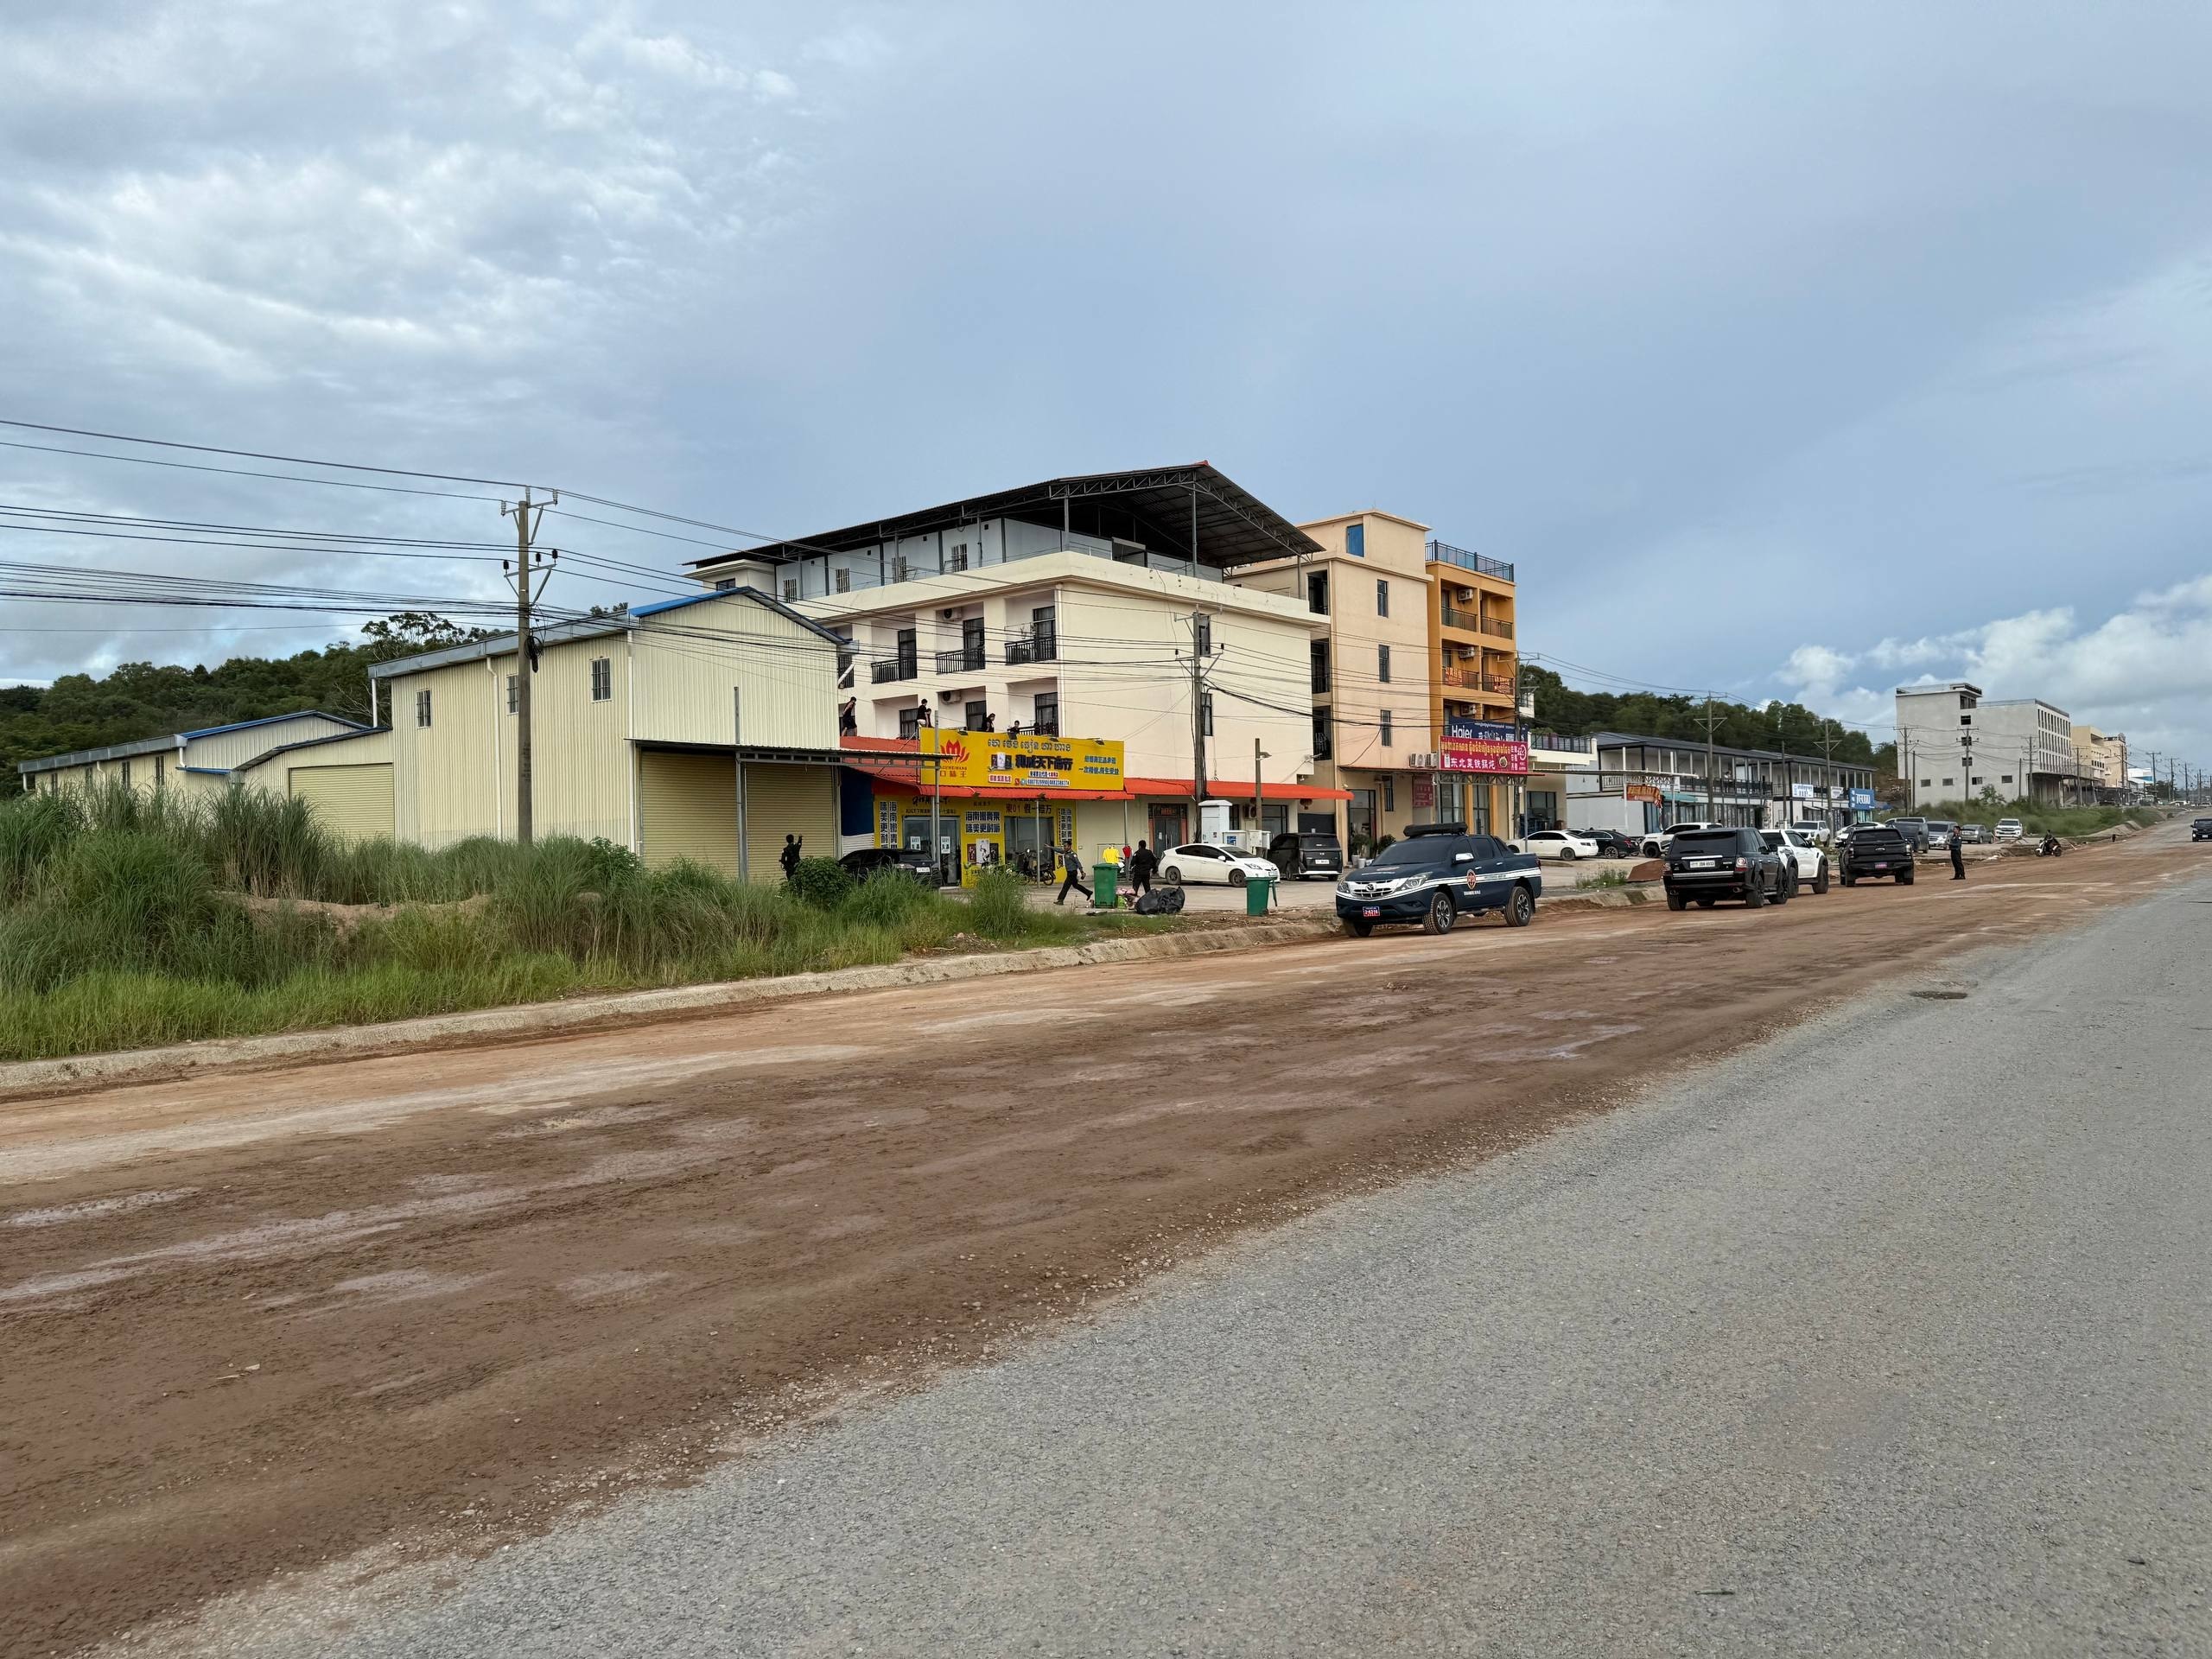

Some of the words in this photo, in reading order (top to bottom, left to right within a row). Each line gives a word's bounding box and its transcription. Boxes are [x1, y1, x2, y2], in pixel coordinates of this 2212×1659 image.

[1452, 724, 1473, 739] Haier
[1015, 753, 1074, 771] 和成天下商行
